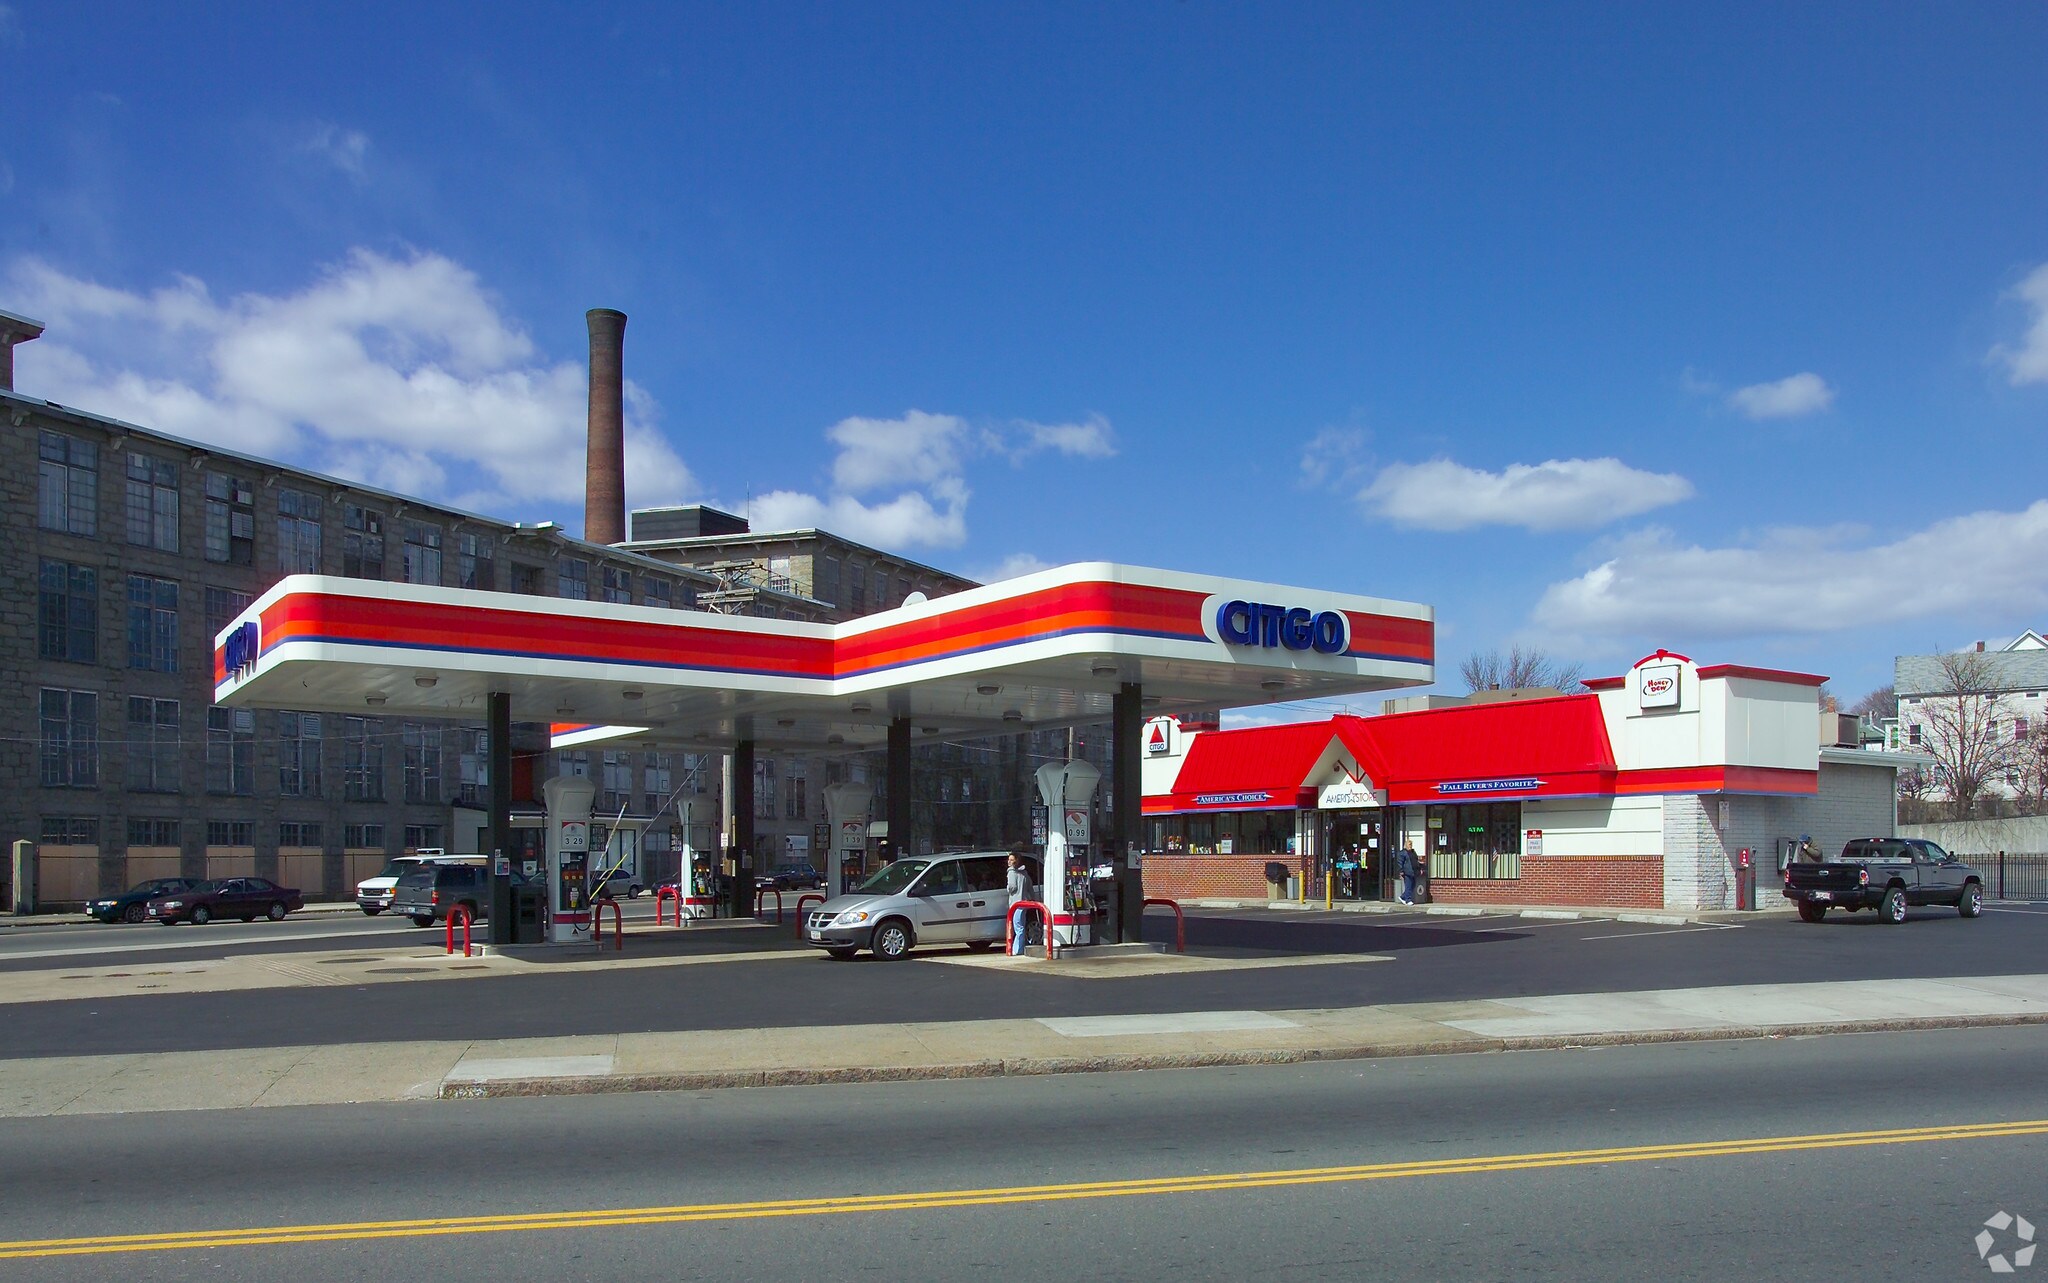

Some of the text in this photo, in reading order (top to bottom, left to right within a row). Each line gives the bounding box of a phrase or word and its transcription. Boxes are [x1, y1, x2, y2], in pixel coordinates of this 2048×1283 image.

[1216, 599, 1345, 655] CITGO
[1647, 679, 1669, 688] HONEY
[1149, 743, 1165, 751] CITGO
[1463, 782, 1493, 790] RIVER'S
[1494, 780, 1533, 788] FAVORITE
[1200, 793, 1263, 803] AMERICA'S CHOICE
[1068, 828, 1086, 837] 0.99
